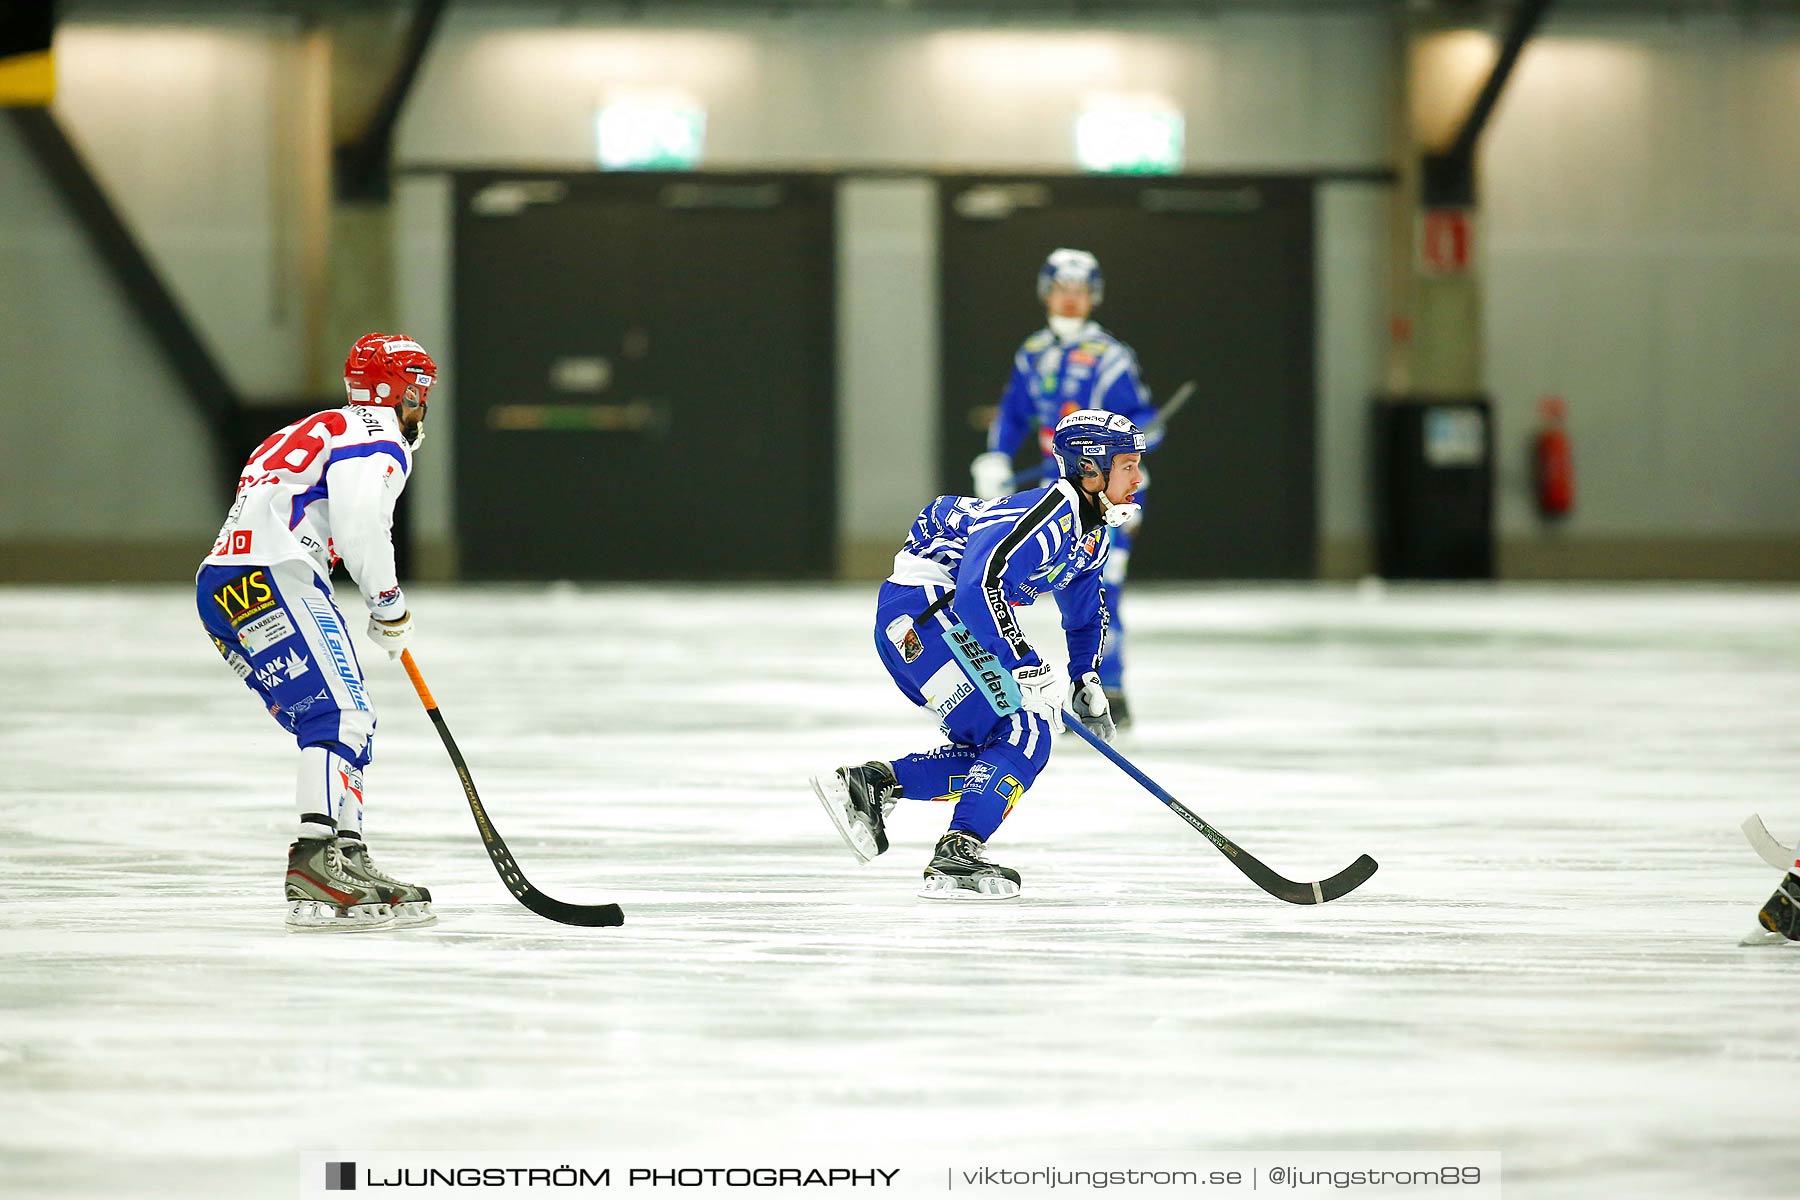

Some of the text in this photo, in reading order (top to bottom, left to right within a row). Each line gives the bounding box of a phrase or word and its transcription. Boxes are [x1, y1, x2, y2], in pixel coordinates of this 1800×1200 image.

[213, 570, 272, 619] YVS
[987, 586, 1006, 620] ince
[981, 669, 1012, 711] data
